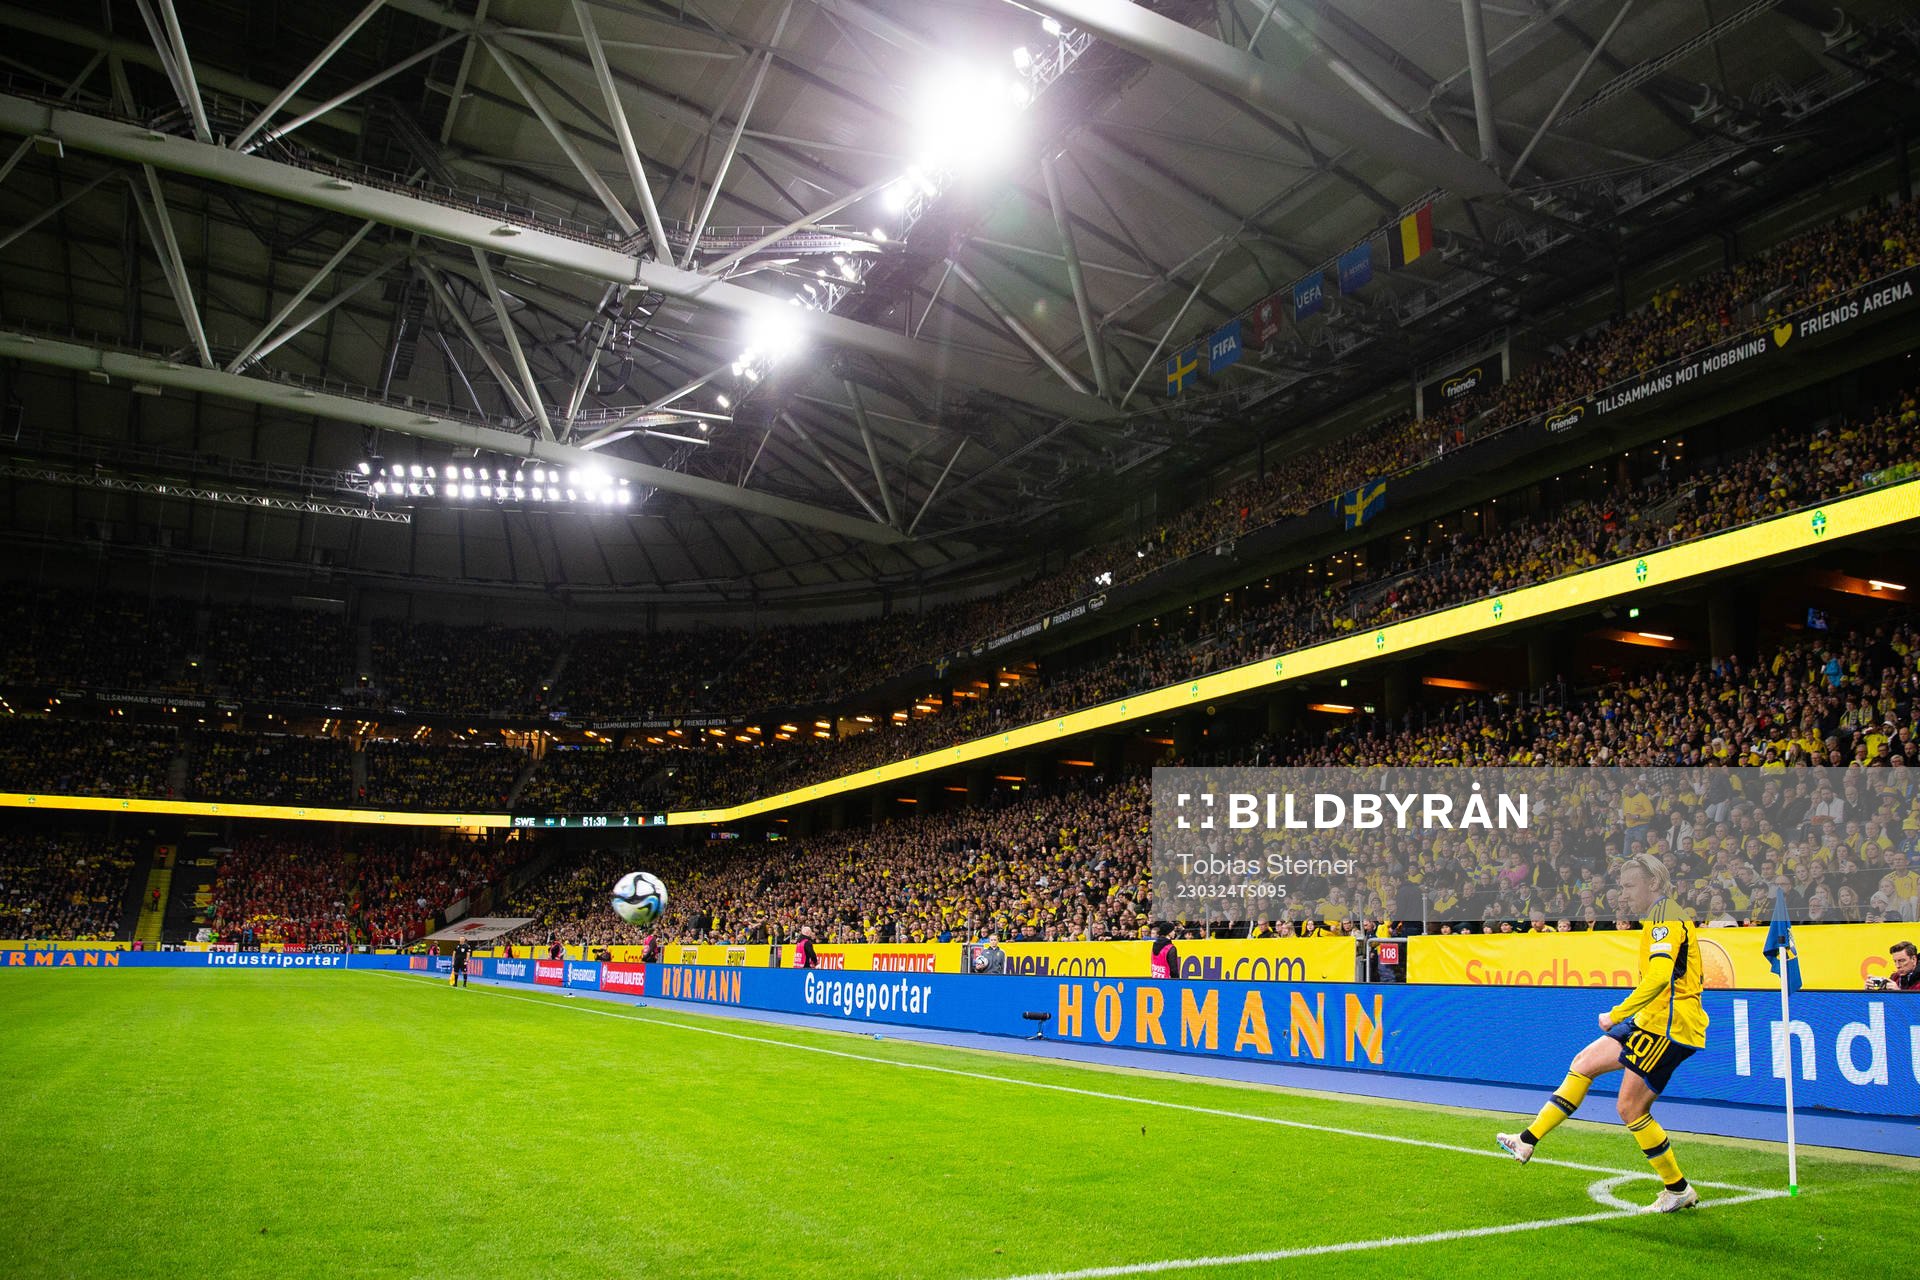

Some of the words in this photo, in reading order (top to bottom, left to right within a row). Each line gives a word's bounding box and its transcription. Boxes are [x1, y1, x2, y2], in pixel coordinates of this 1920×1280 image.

[1296, 284, 1322, 309] UEFA
[1212, 335, 1237, 360] FIFA
[1596, 374, 1673, 415] TILLSAMMANS
[1675, 363, 1699, 385] MOT
[1702, 337, 1766, 373] MOBBNING
[1800, 303, 1859, 338] FRIENDS
[1862, 281, 1913, 315] ARENA
[1447, 378, 1476, 397] friends
[1550, 414, 1579, 432] friends
[96, 692, 149, 703] TILLSAMMANS
[150, 697, 166, 705] MOT
[515, 817, 535, 826] SWE
[560, 817, 566, 827] 0
[583, 816, 607, 826] 51:30
[623, 817, 629, 826] 2
[653, 816, 665, 825] BEL
[0, 952, 120, 966] RMANN
[208, 953, 340, 967] Industriportar
[1381, 948, 1396, 959] 108
[873, 954, 936, 973] BAUHAUS
[662, 966, 742, 1003] HÖRMANN
[805, 972, 931, 1016] Garageportar
[1058, 981, 1383, 1064] HÖRMANN
[1626, 1030, 1654, 1057] 10
